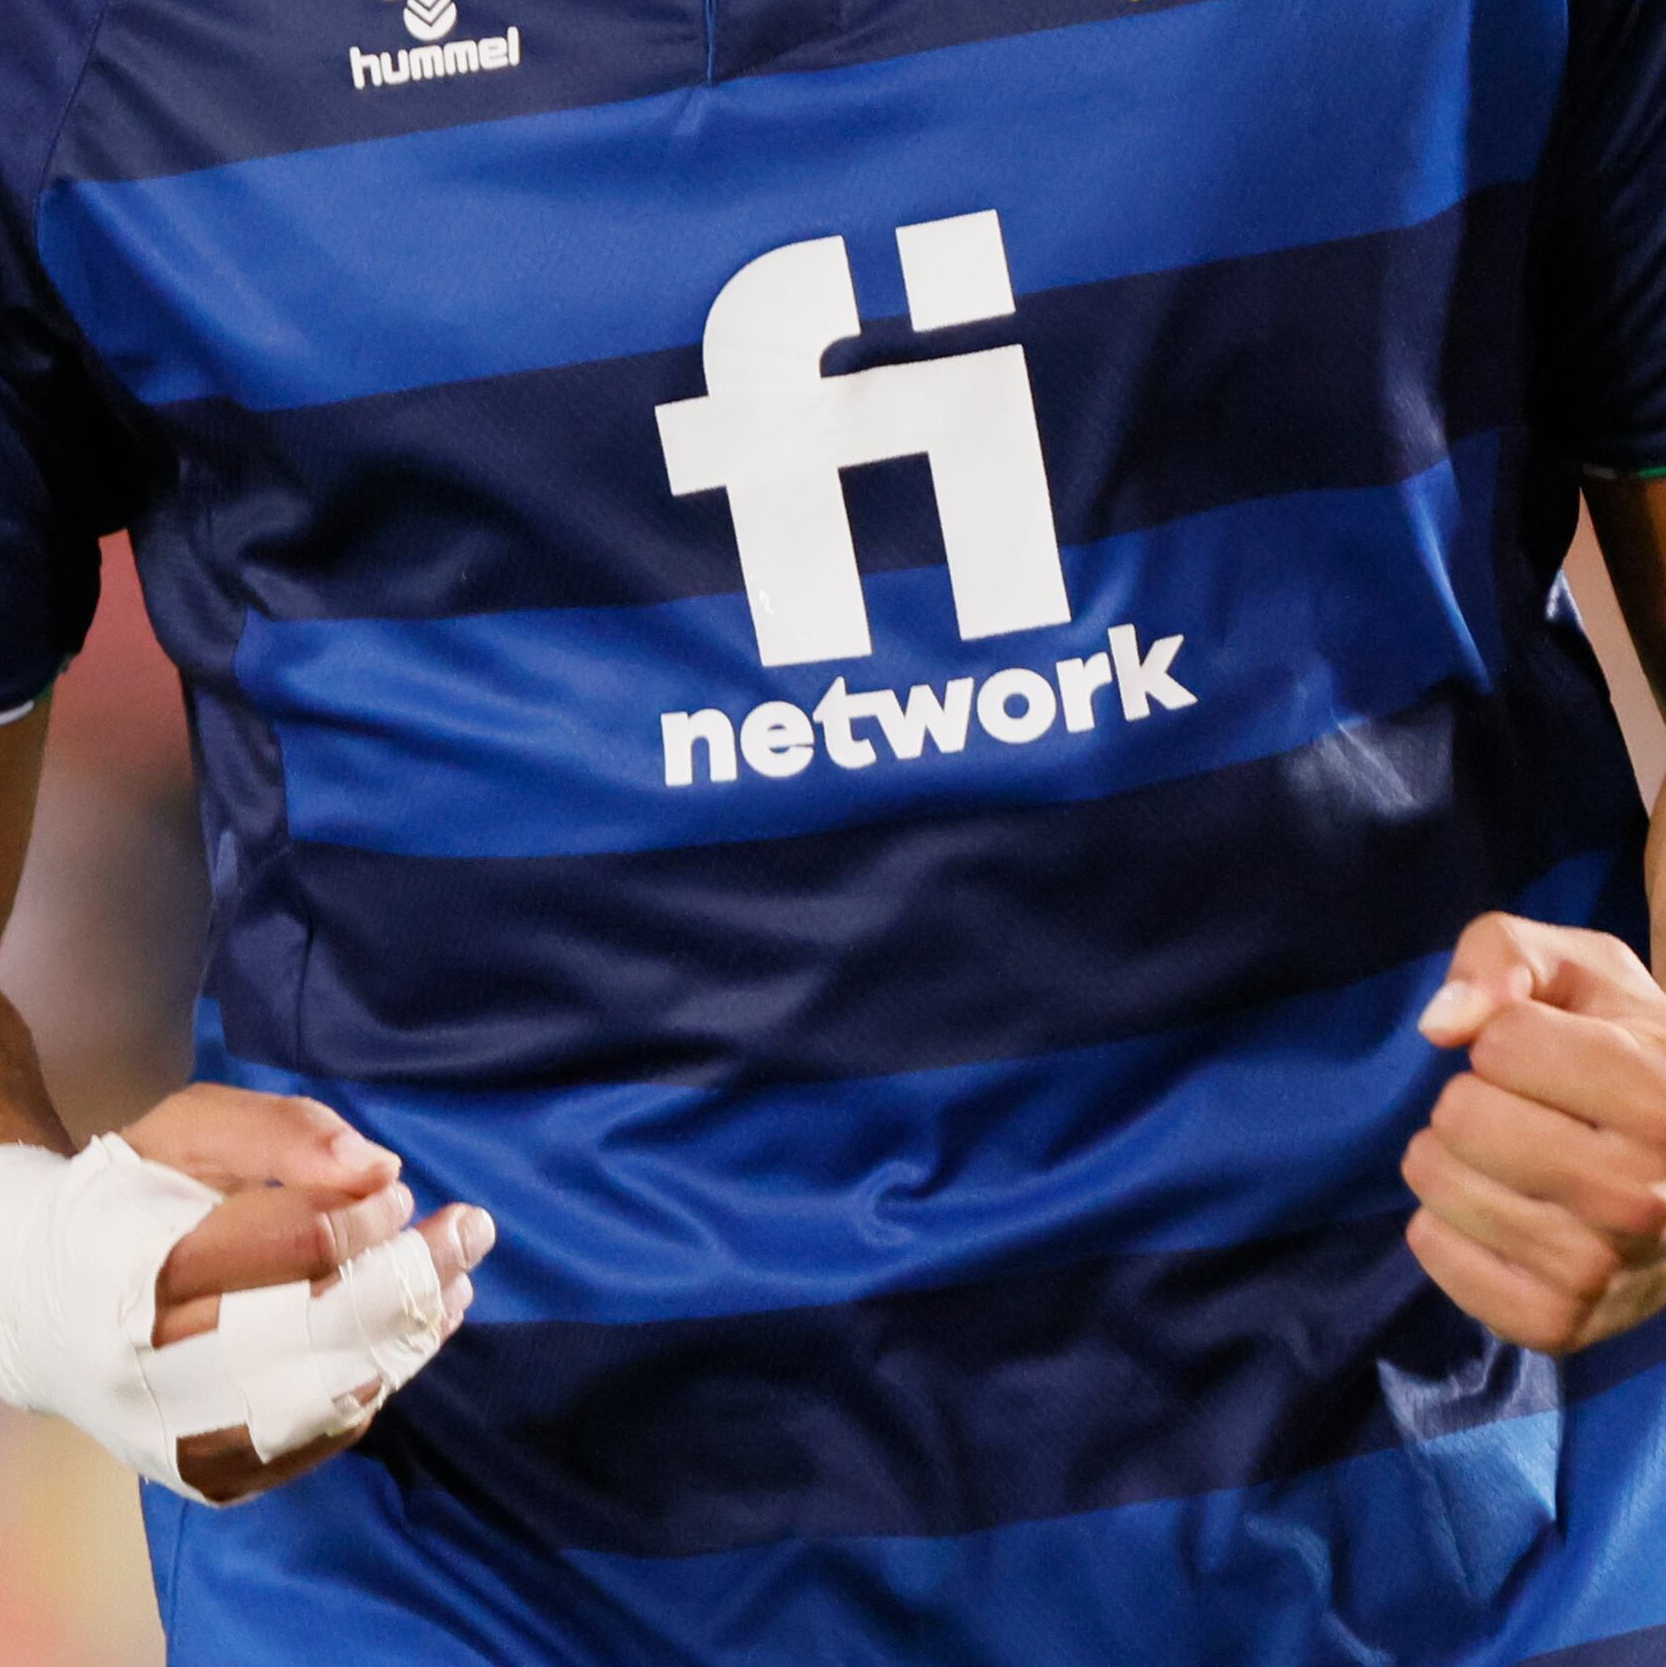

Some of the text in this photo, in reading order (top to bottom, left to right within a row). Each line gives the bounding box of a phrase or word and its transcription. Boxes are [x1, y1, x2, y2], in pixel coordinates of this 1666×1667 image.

[349, 26, 520, 90] hummel
[654, 209, 1072, 667] fi
[661, 623, 1199, 787] network
